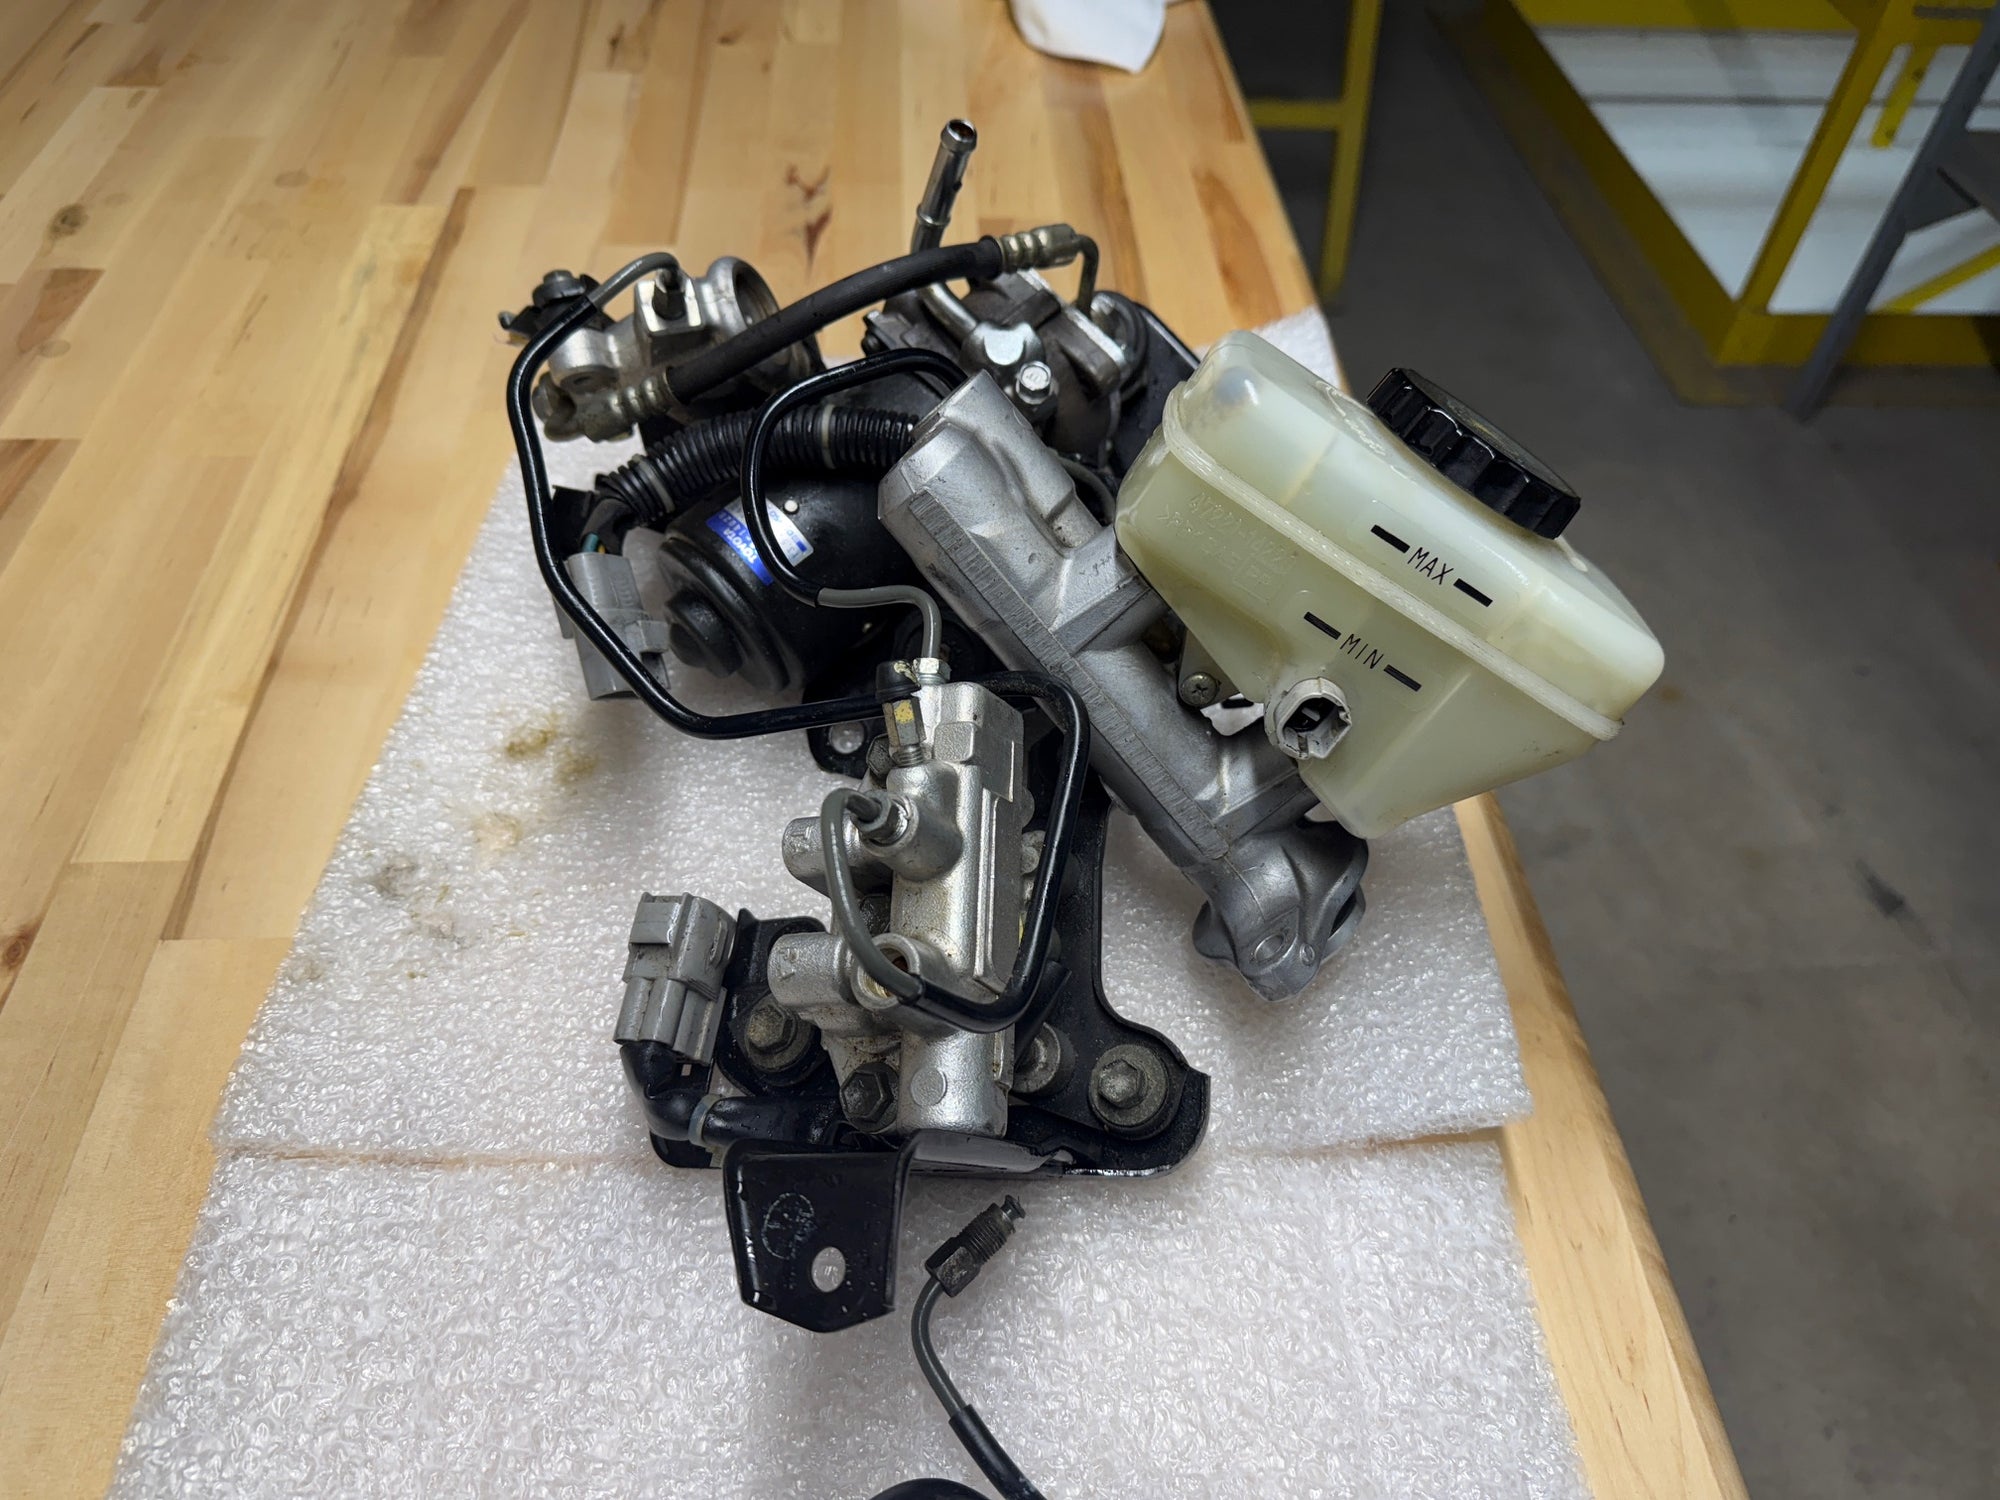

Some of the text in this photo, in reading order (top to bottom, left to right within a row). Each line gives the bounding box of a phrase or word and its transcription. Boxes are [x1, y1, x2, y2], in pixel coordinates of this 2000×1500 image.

[722, 527, 757, 564] TOYOTA
[1407, 547, 1454, 585] MAX
[1339, 633, 1385, 669] MIN
